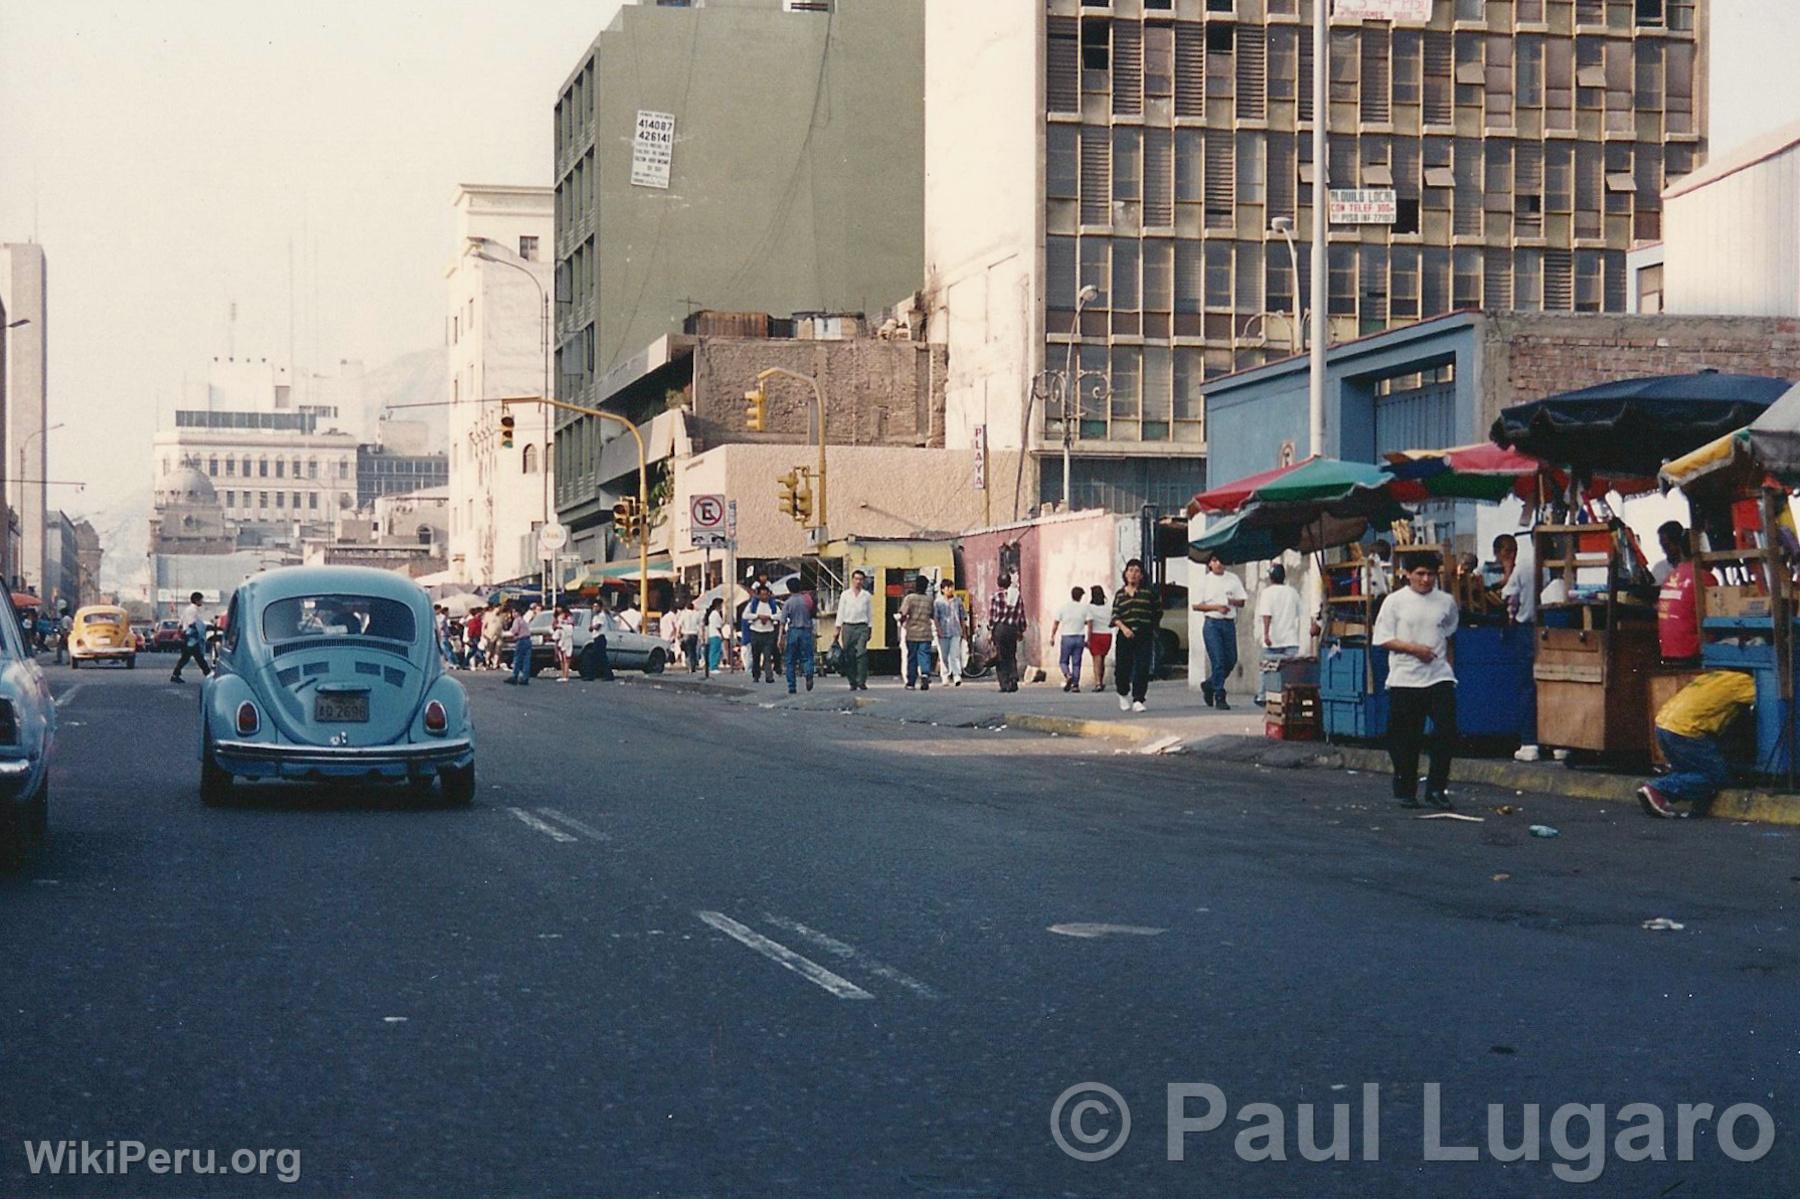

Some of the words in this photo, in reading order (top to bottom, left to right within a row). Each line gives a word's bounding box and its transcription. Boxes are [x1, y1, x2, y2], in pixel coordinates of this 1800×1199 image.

[639, 119, 672, 131] 414087
[639, 131, 671, 143] 426141
[1369, 191, 1393, 202] LOCAL
[1331, 203, 1345, 212] CON
[975, 428, 983, 485] PLAYA
[702, 502, 713, 520] E
